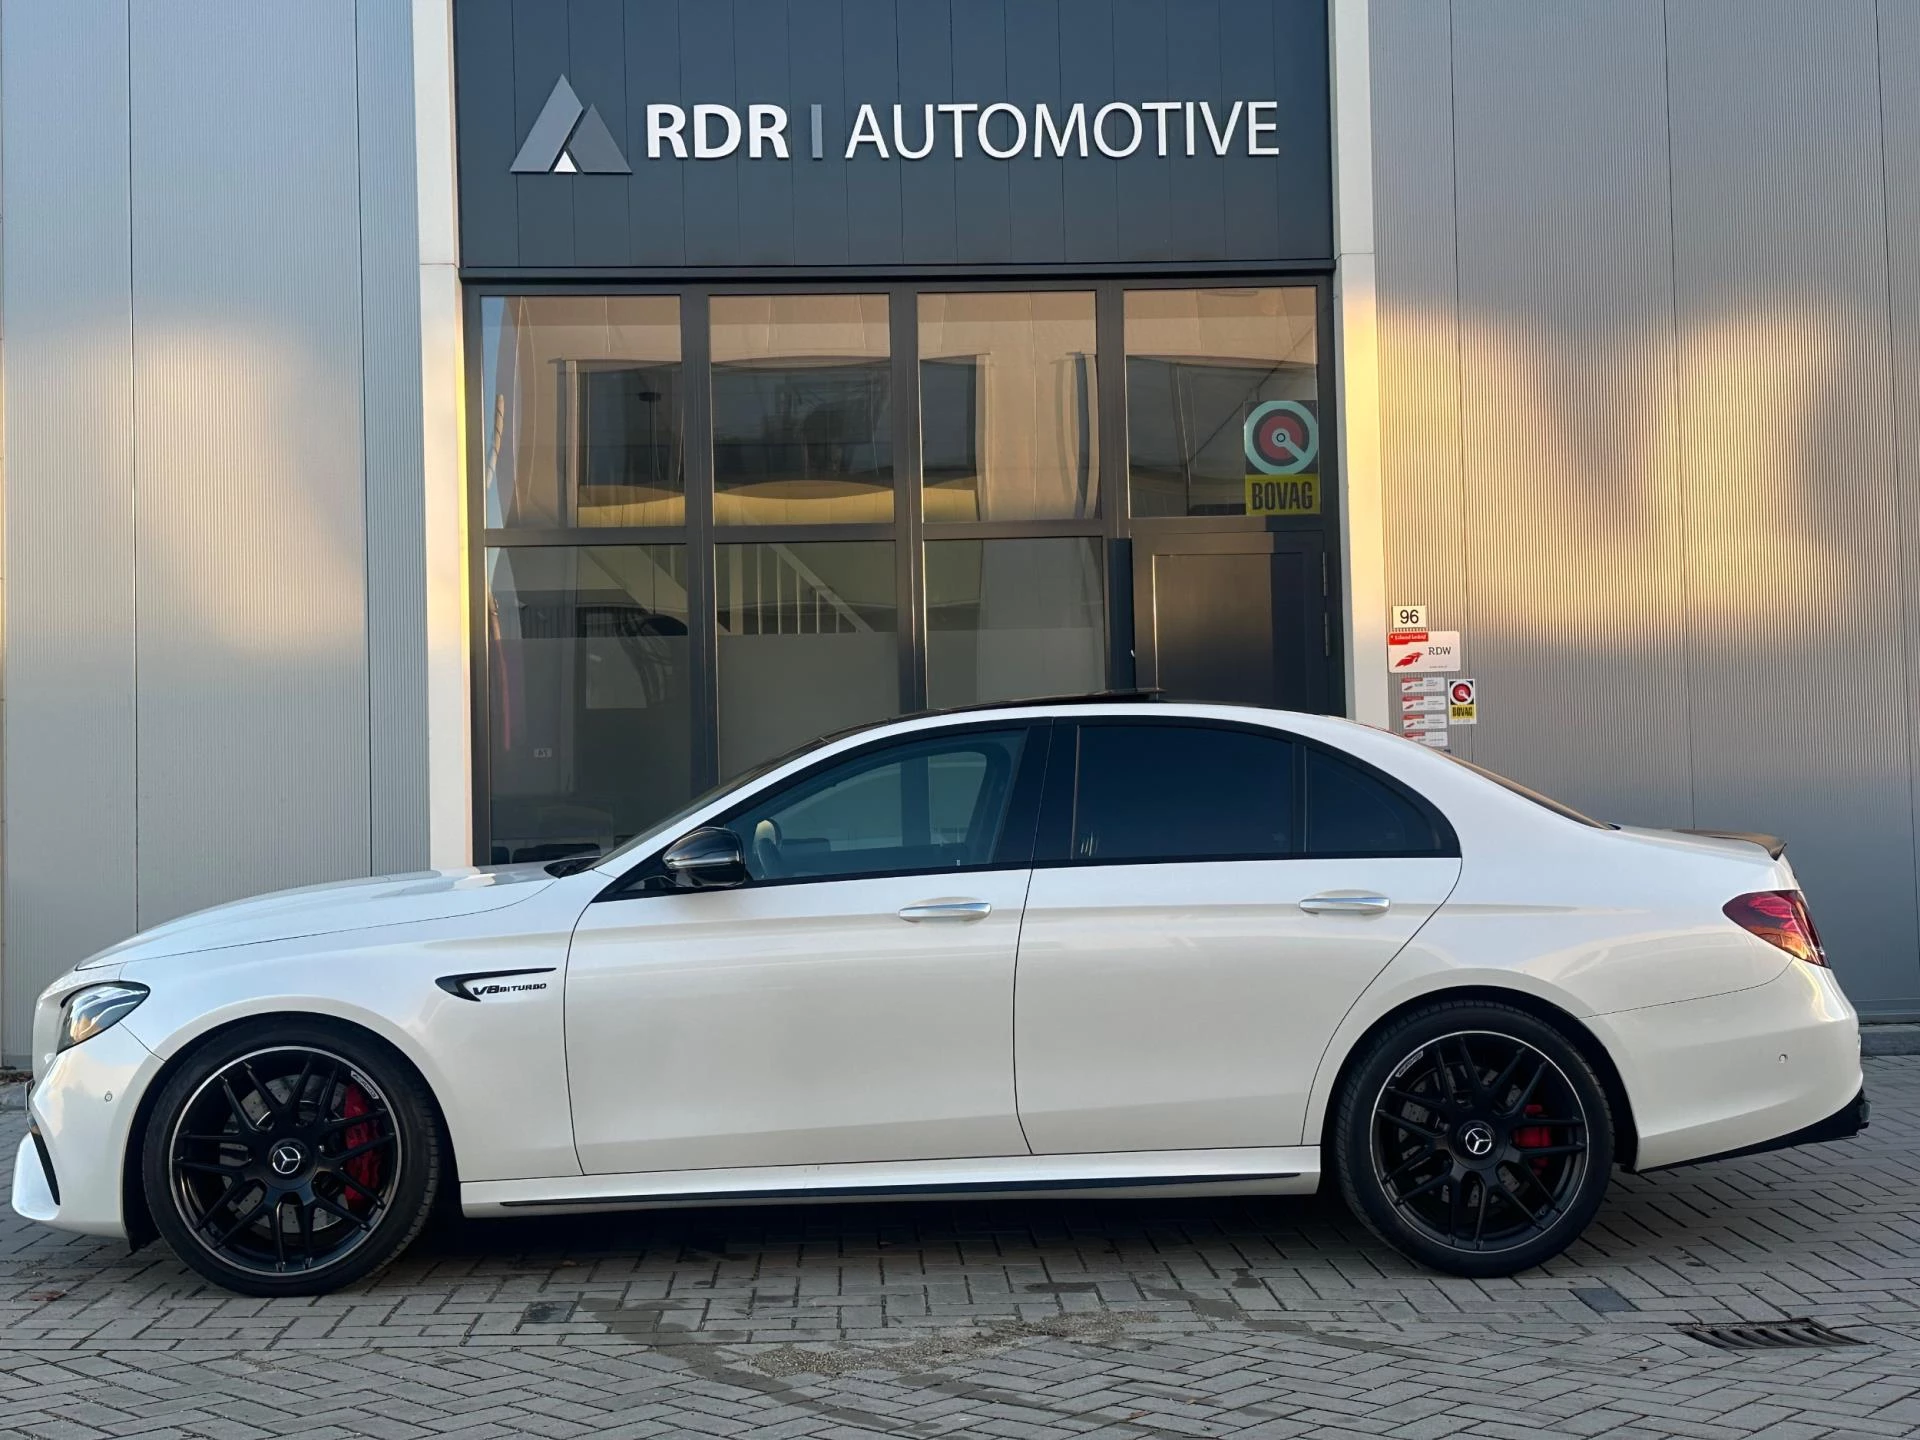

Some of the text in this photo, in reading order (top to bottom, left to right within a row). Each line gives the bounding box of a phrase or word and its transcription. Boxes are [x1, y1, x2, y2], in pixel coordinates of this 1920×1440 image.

[645, 100, 1280, 161] RDR AUTOMOTIVE
[1252, 482, 1312, 510] BOVAG
[1400, 609, 1419, 624] 96
[1428, 646, 1452, 656] RDW
[1452, 706, 1473, 717] BOVAG
